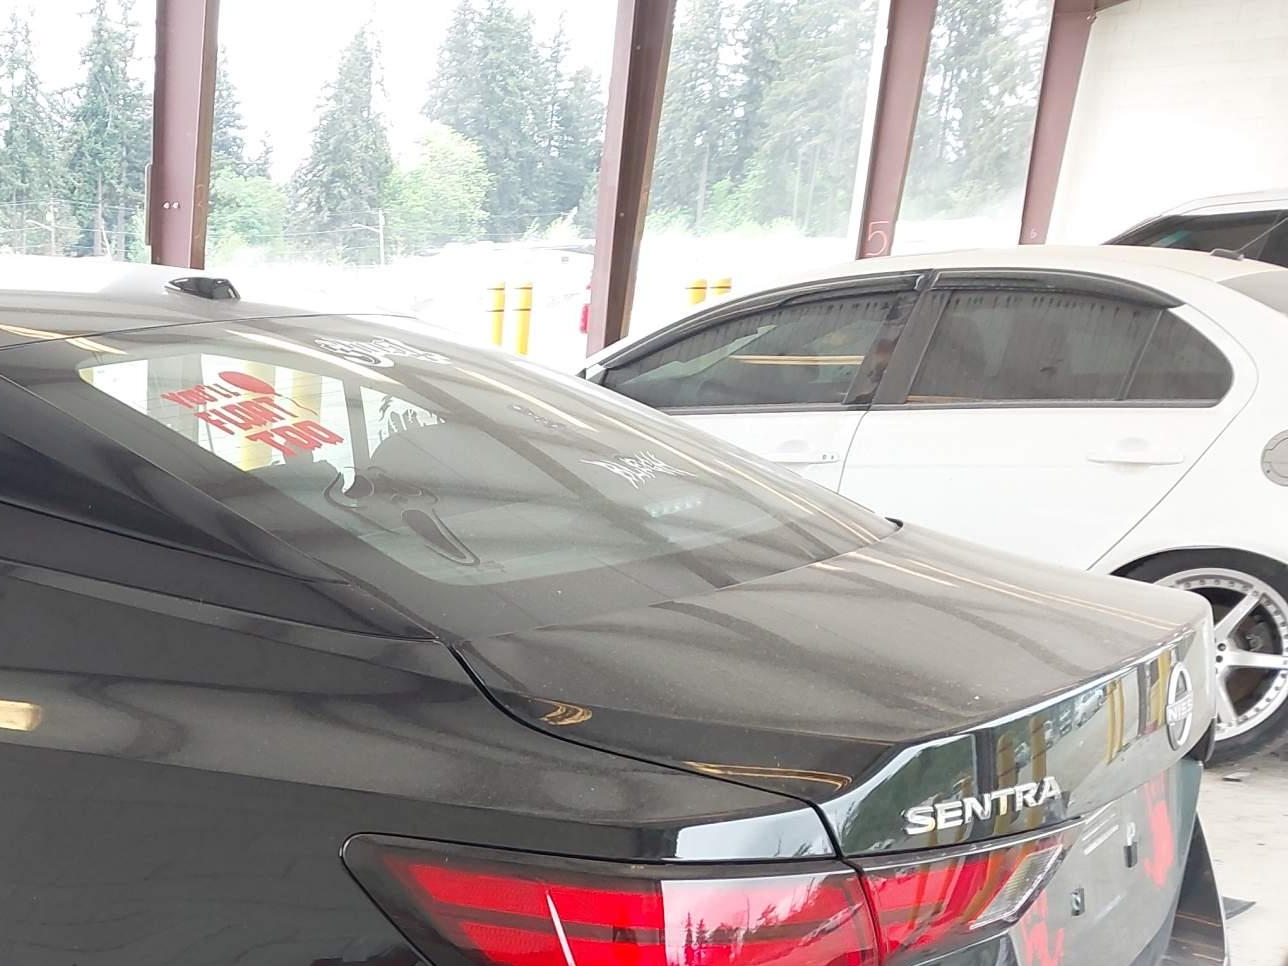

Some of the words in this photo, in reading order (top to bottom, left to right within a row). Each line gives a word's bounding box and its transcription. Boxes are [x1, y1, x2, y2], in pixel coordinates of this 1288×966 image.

[865, 220, 889, 256] 5
[246, 420, 344, 457] TOO
[902, 776, 1062, 835] SENTRA
